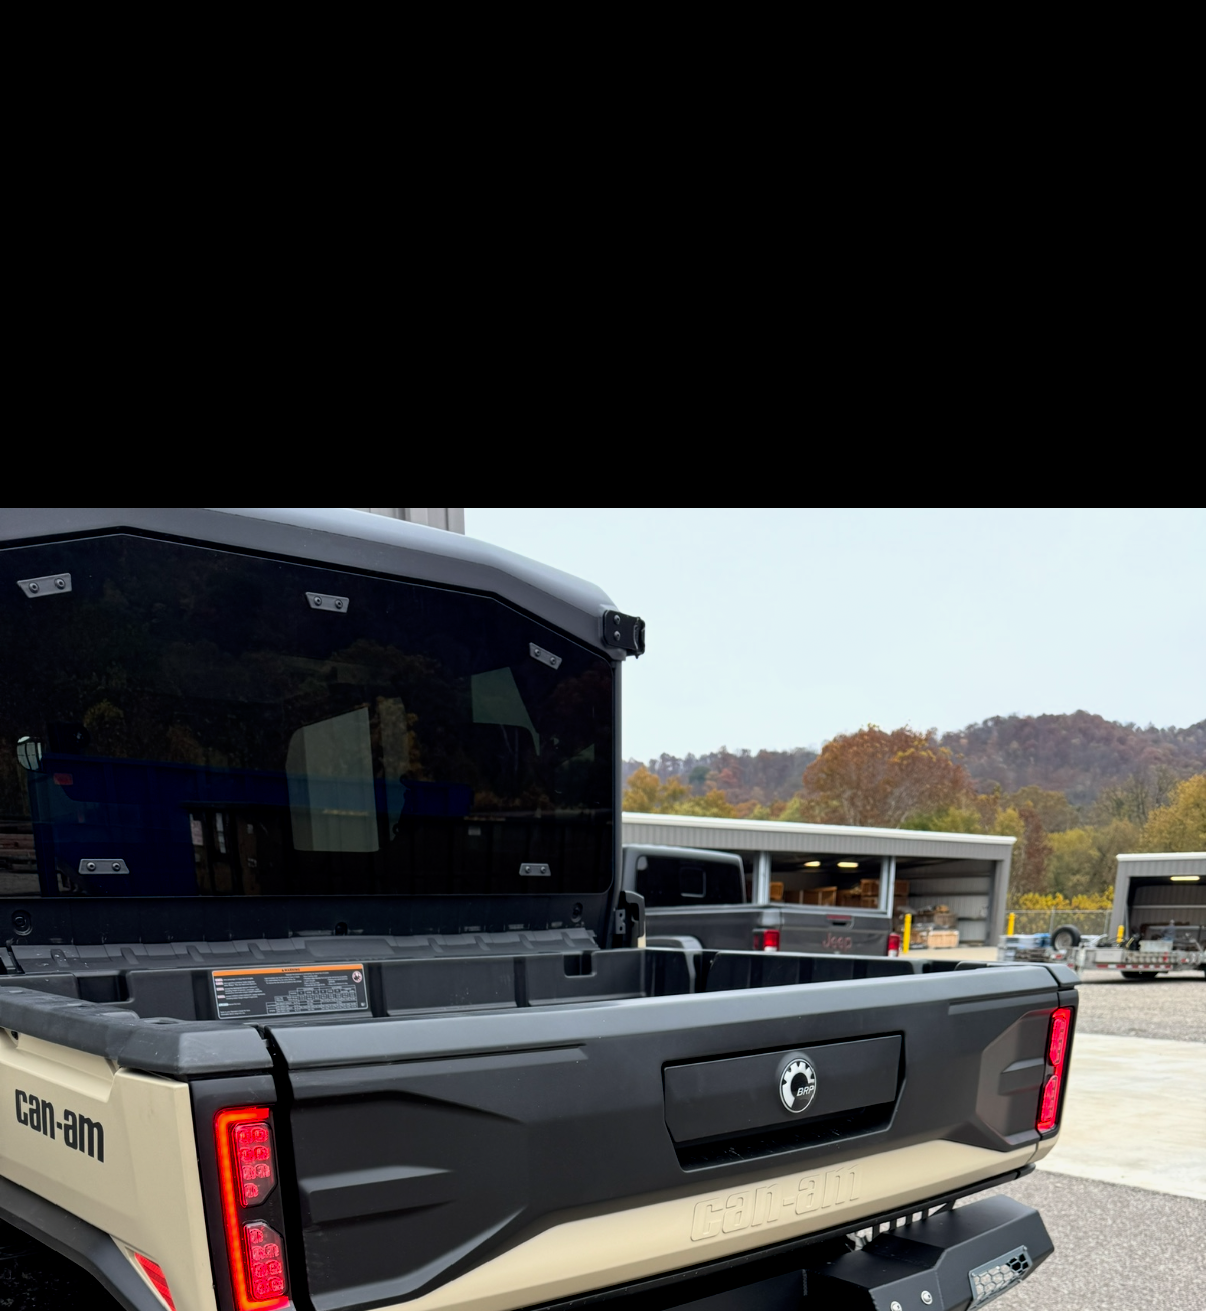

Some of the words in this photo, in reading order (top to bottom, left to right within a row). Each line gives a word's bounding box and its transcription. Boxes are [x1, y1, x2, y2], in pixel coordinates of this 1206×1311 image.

[822, 932, 852, 951] Jeep
[796, 1085, 815, 1097] BRP
[15, 1088, 104, 1163] can-am
[690, 1164, 862, 1242] can-am
